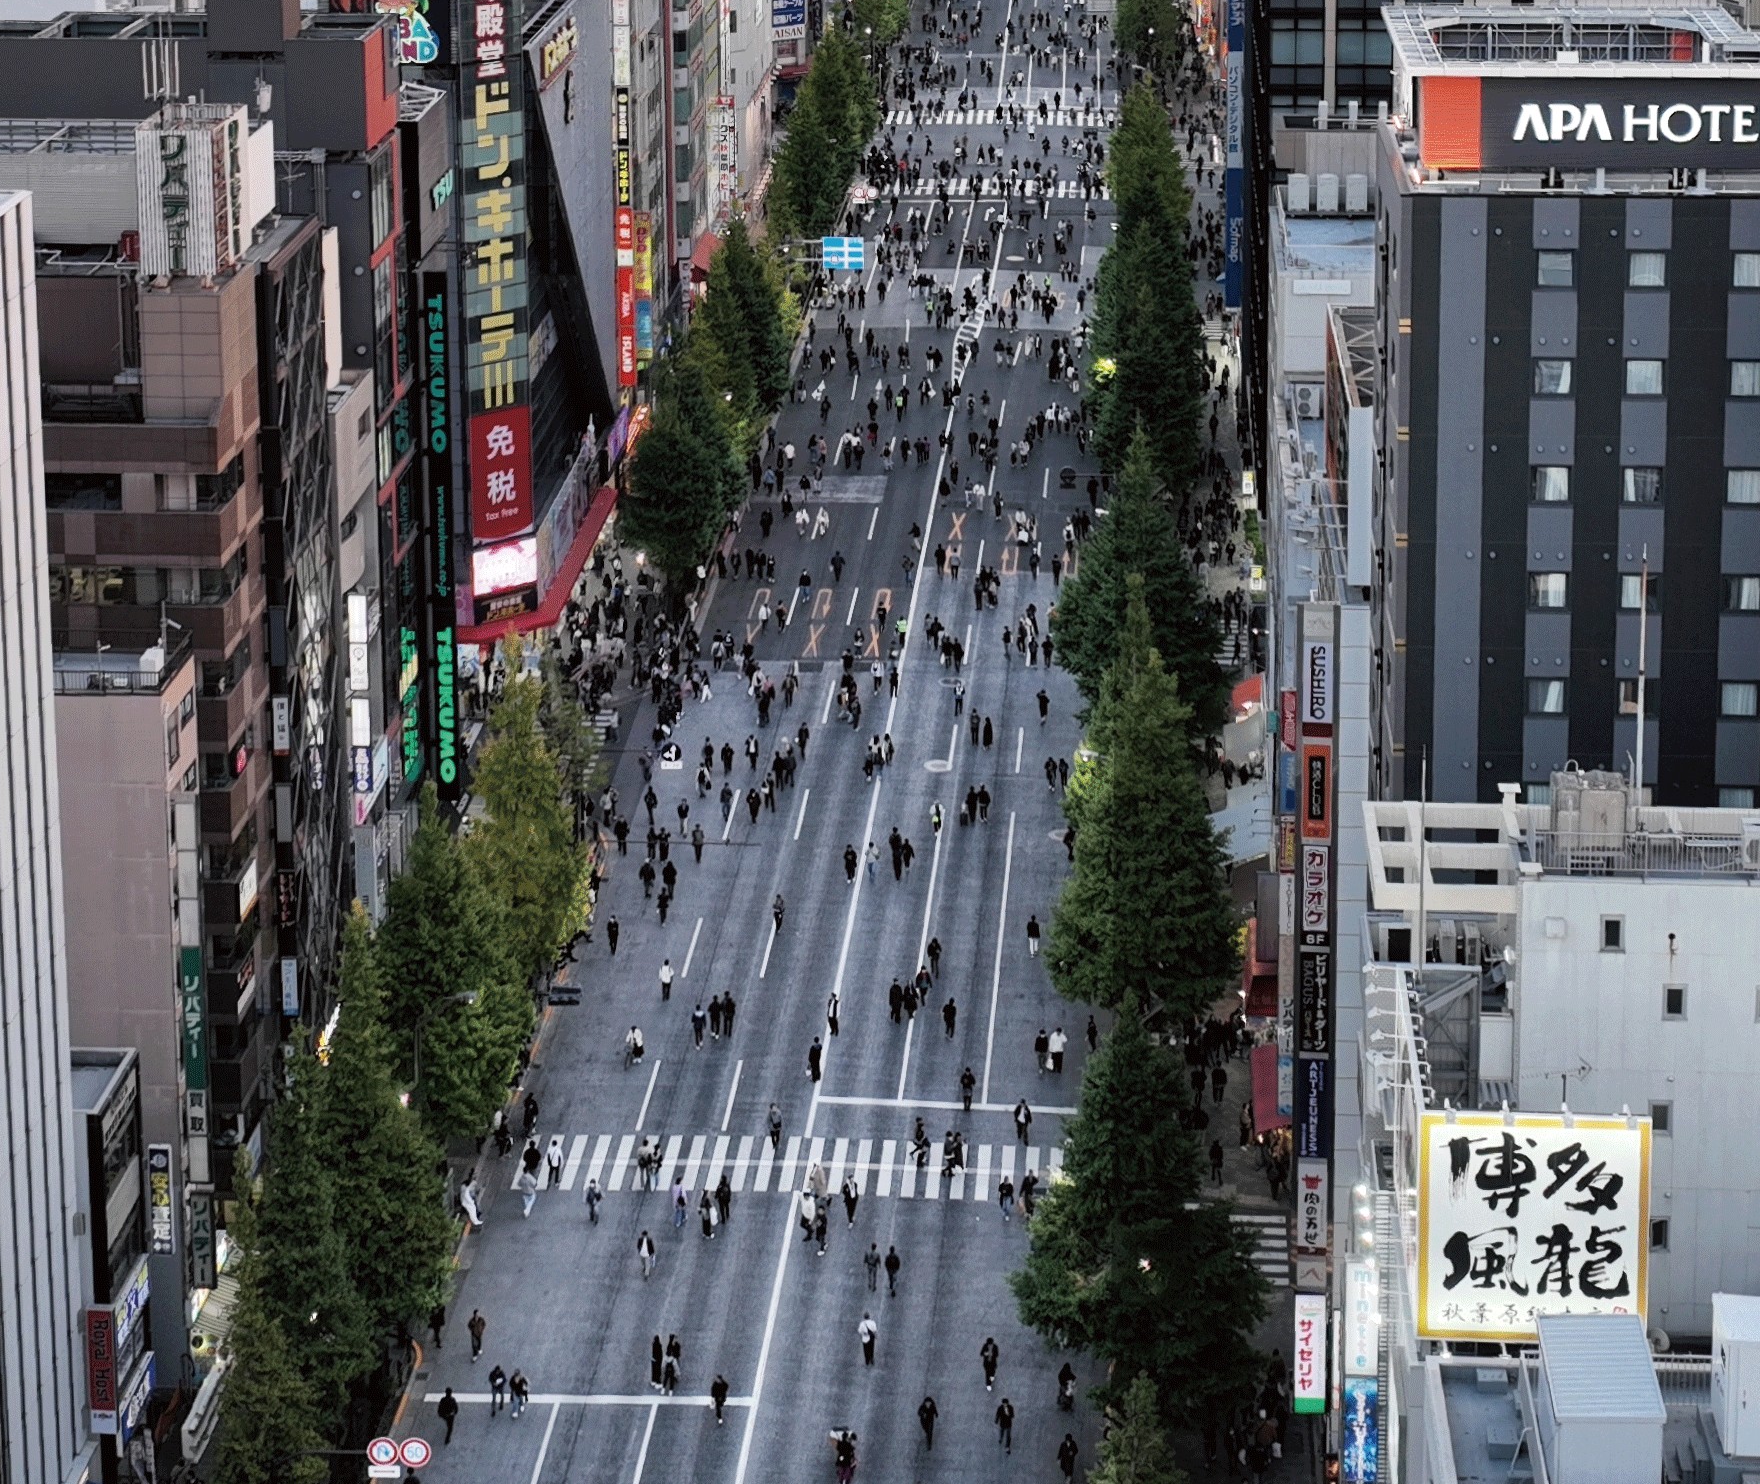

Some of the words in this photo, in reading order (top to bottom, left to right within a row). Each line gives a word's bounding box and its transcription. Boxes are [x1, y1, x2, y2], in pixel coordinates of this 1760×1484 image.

[775, 27, 803, 38] AISAN
[1513, 103, 1613, 142] APA
[475, 80, 515, 364] ドン・キホーテ
[1229, 216, 1241, 263] Sofmap
[427, 293, 448, 454] TSUKUMO
[486, 424, 517, 506] 免税
[436, 626, 456, 783] TSUKUMO
[1312, 646, 1326, 721] SUSHIRO
[1306, 851, 1326, 926] カラオケ
[184, 975, 202, 1058] リバティー
[189, 1093, 206, 1133] 買取
[1440, 1131, 1626, 1218] 博多
[1304, 1192, 1320, 1245] 肉の万世
[1442, 1222, 1631, 1299] 風龍
[98, 1319, 109, 1363] Royal
[1354, 1269, 1372, 1367] minette
[1442, 1302, 1603, 1324] 秋葉原総
[98, 1368, 109, 1404] Host
[1299, 1318, 1314, 1391] サイゼリヤ
